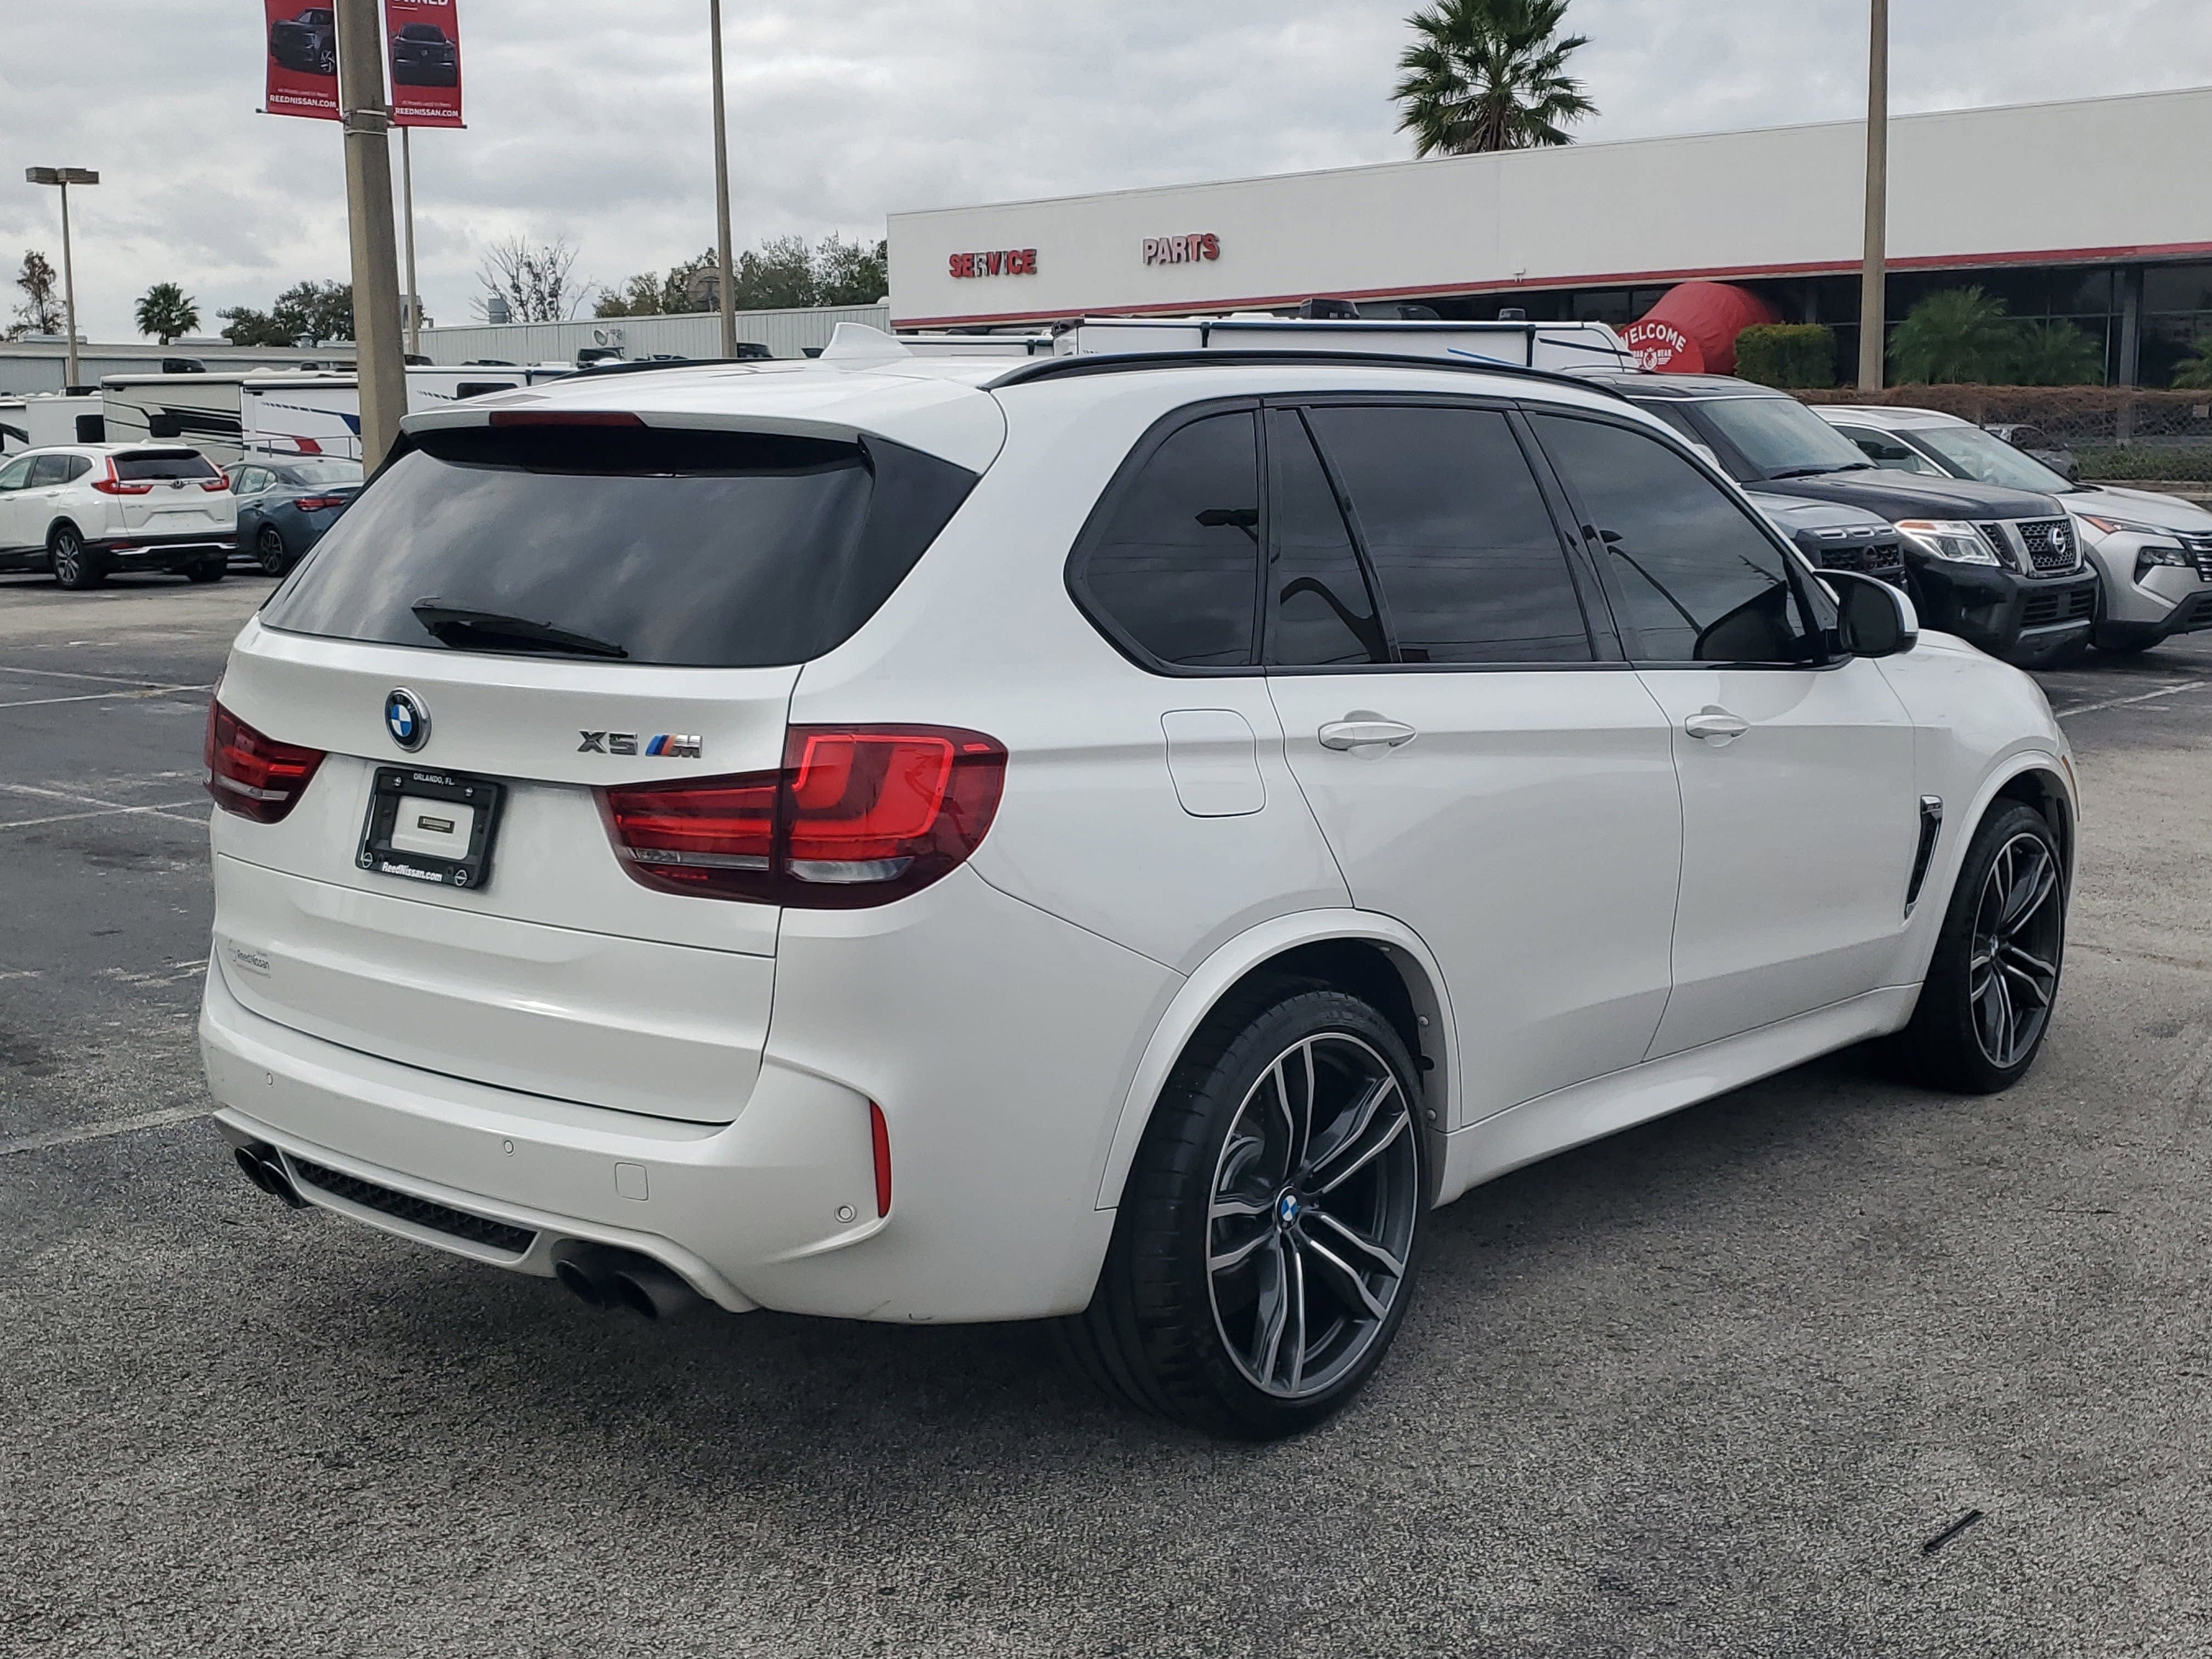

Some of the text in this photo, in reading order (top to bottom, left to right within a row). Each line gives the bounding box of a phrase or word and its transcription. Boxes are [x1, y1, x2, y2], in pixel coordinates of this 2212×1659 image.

[270, 94, 336, 108] REEDNISSAN.COM
[395, 107, 459, 117] REEDNISSAN.COM
[1143, 233, 1220, 265] PARTS
[949, 249, 1037, 278] SERVICE
[577, 730, 638, 756] X5
[413, 772, 444, 785] ORLANDO,
[382, 862, 442, 882] ReedNissan.com
